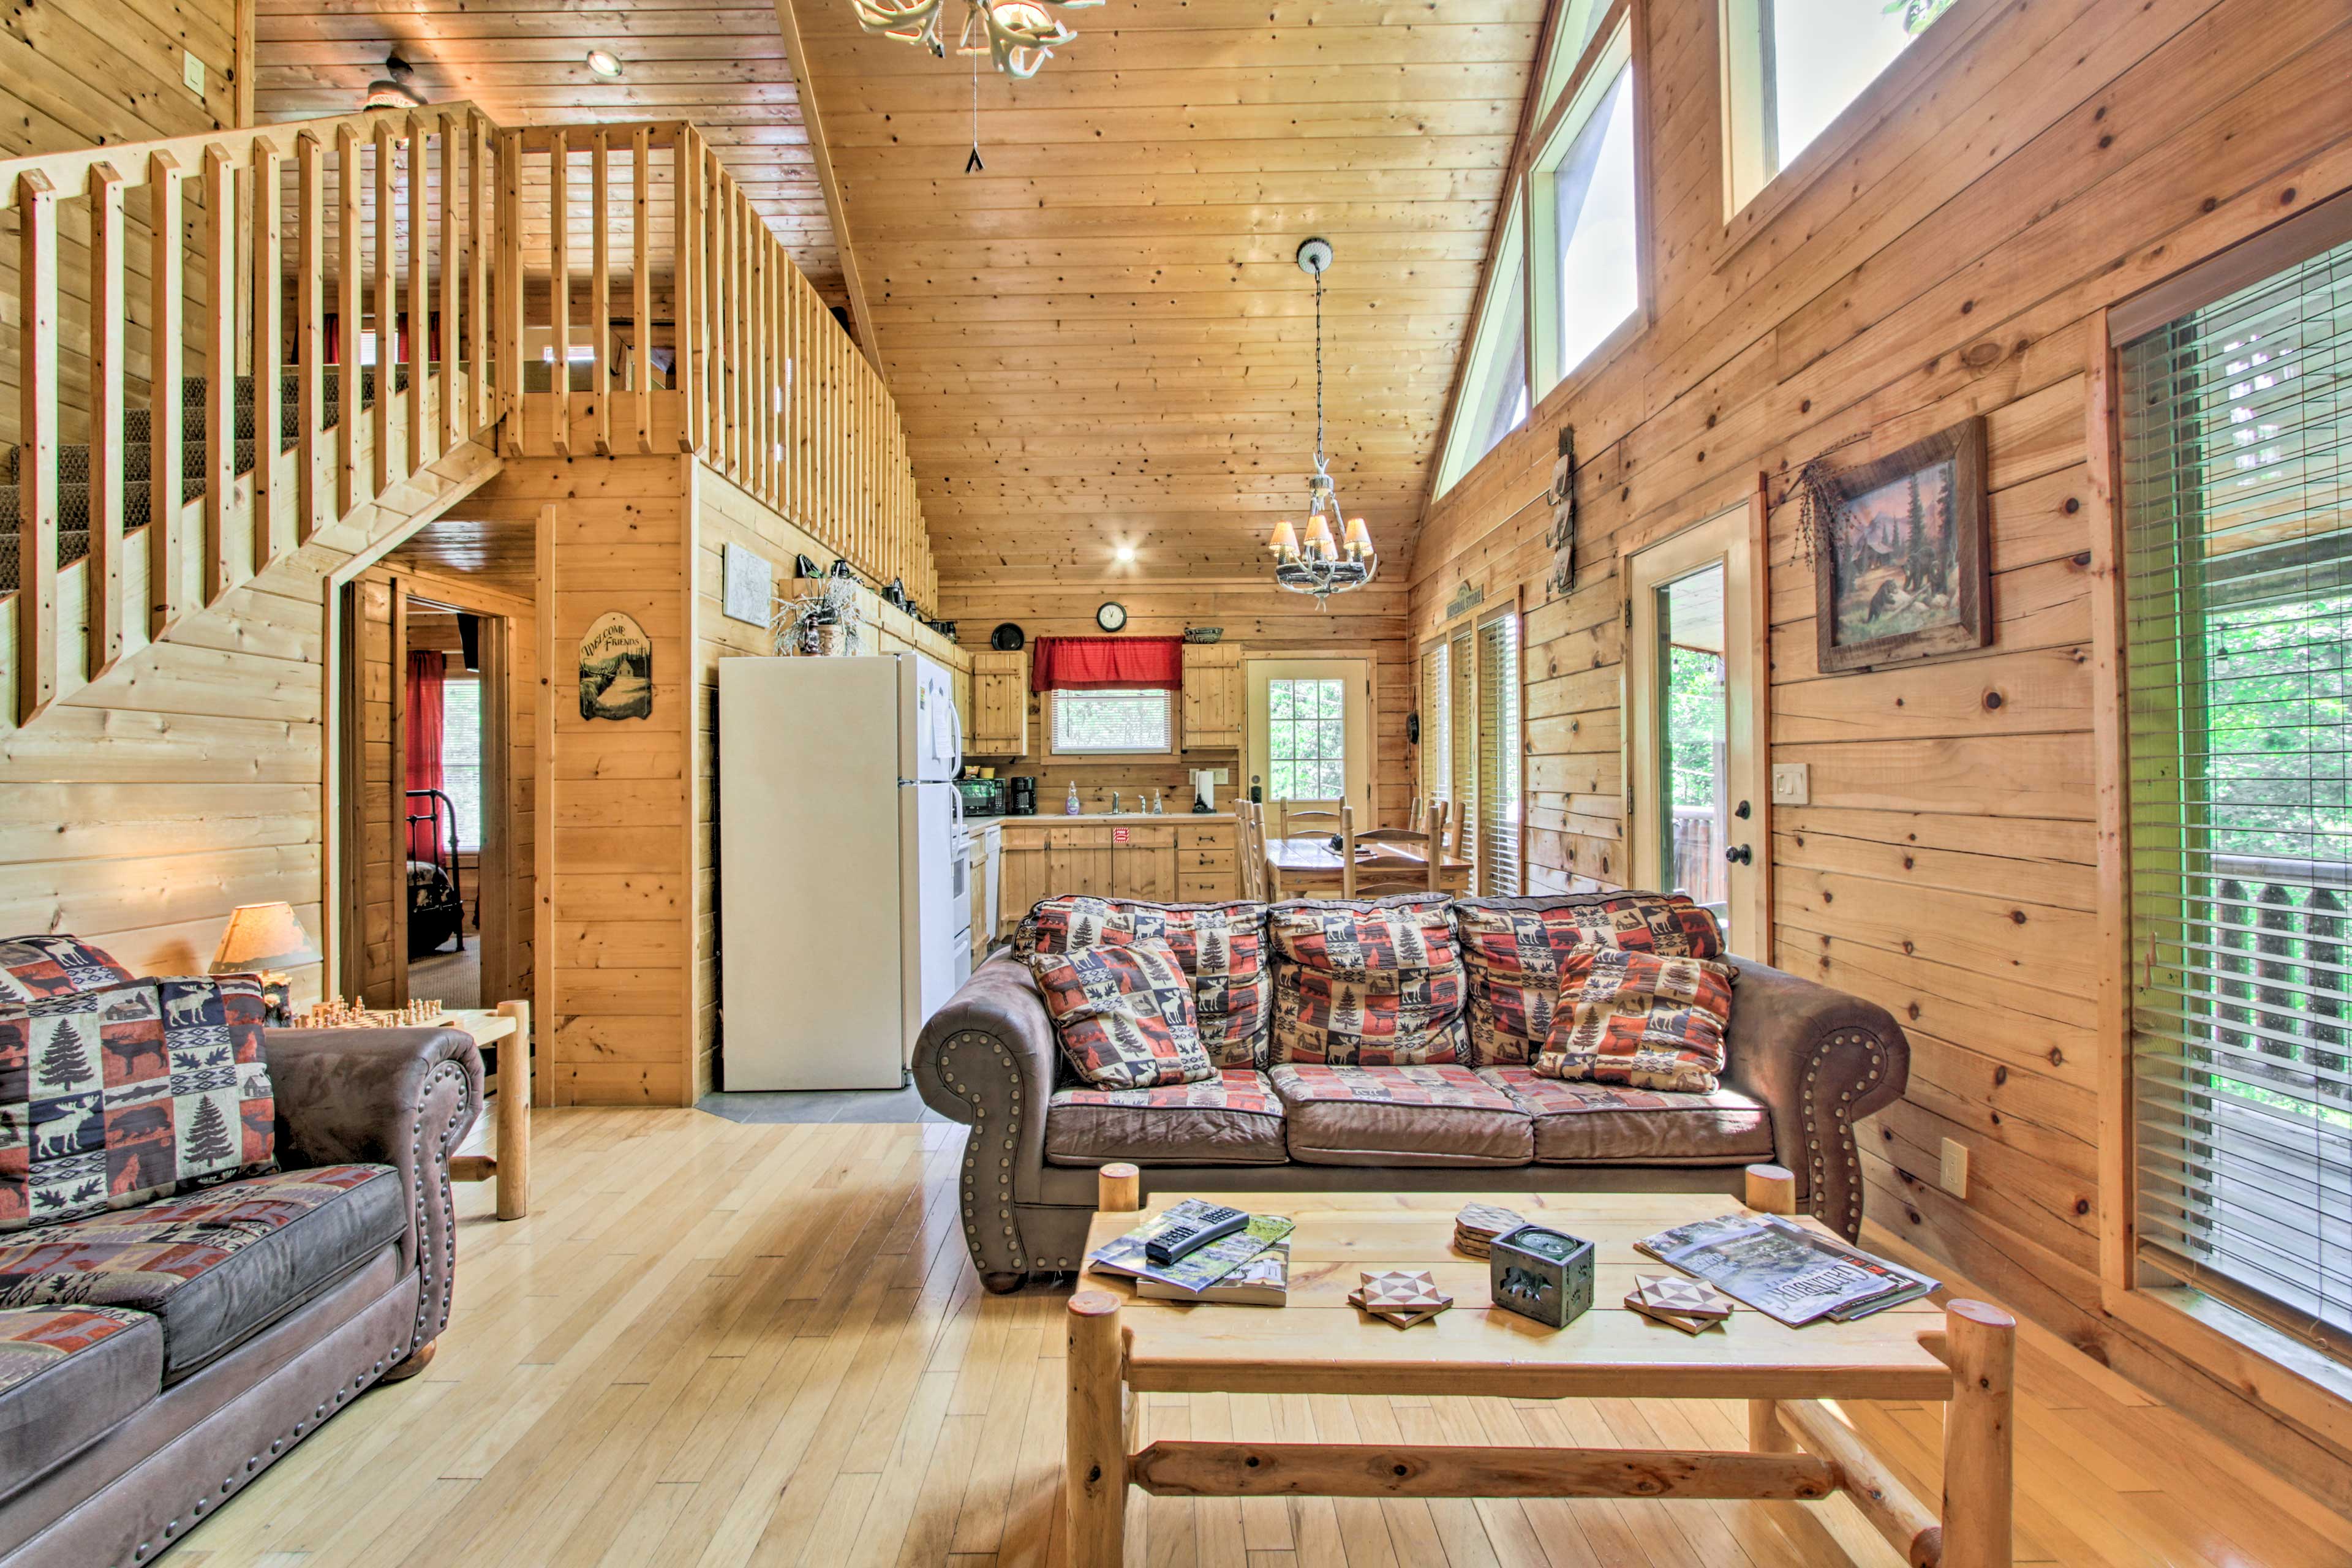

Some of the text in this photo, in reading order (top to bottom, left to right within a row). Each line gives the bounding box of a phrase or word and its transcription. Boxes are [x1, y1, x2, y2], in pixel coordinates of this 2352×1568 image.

[1447, 590, 1480, 618] GENERAL STORE
[581, 625, 625, 657] WELCOME
[603, 636, 639, 652] FRIENDS
[1755, 1264, 1869, 1311] GATLINBURG
